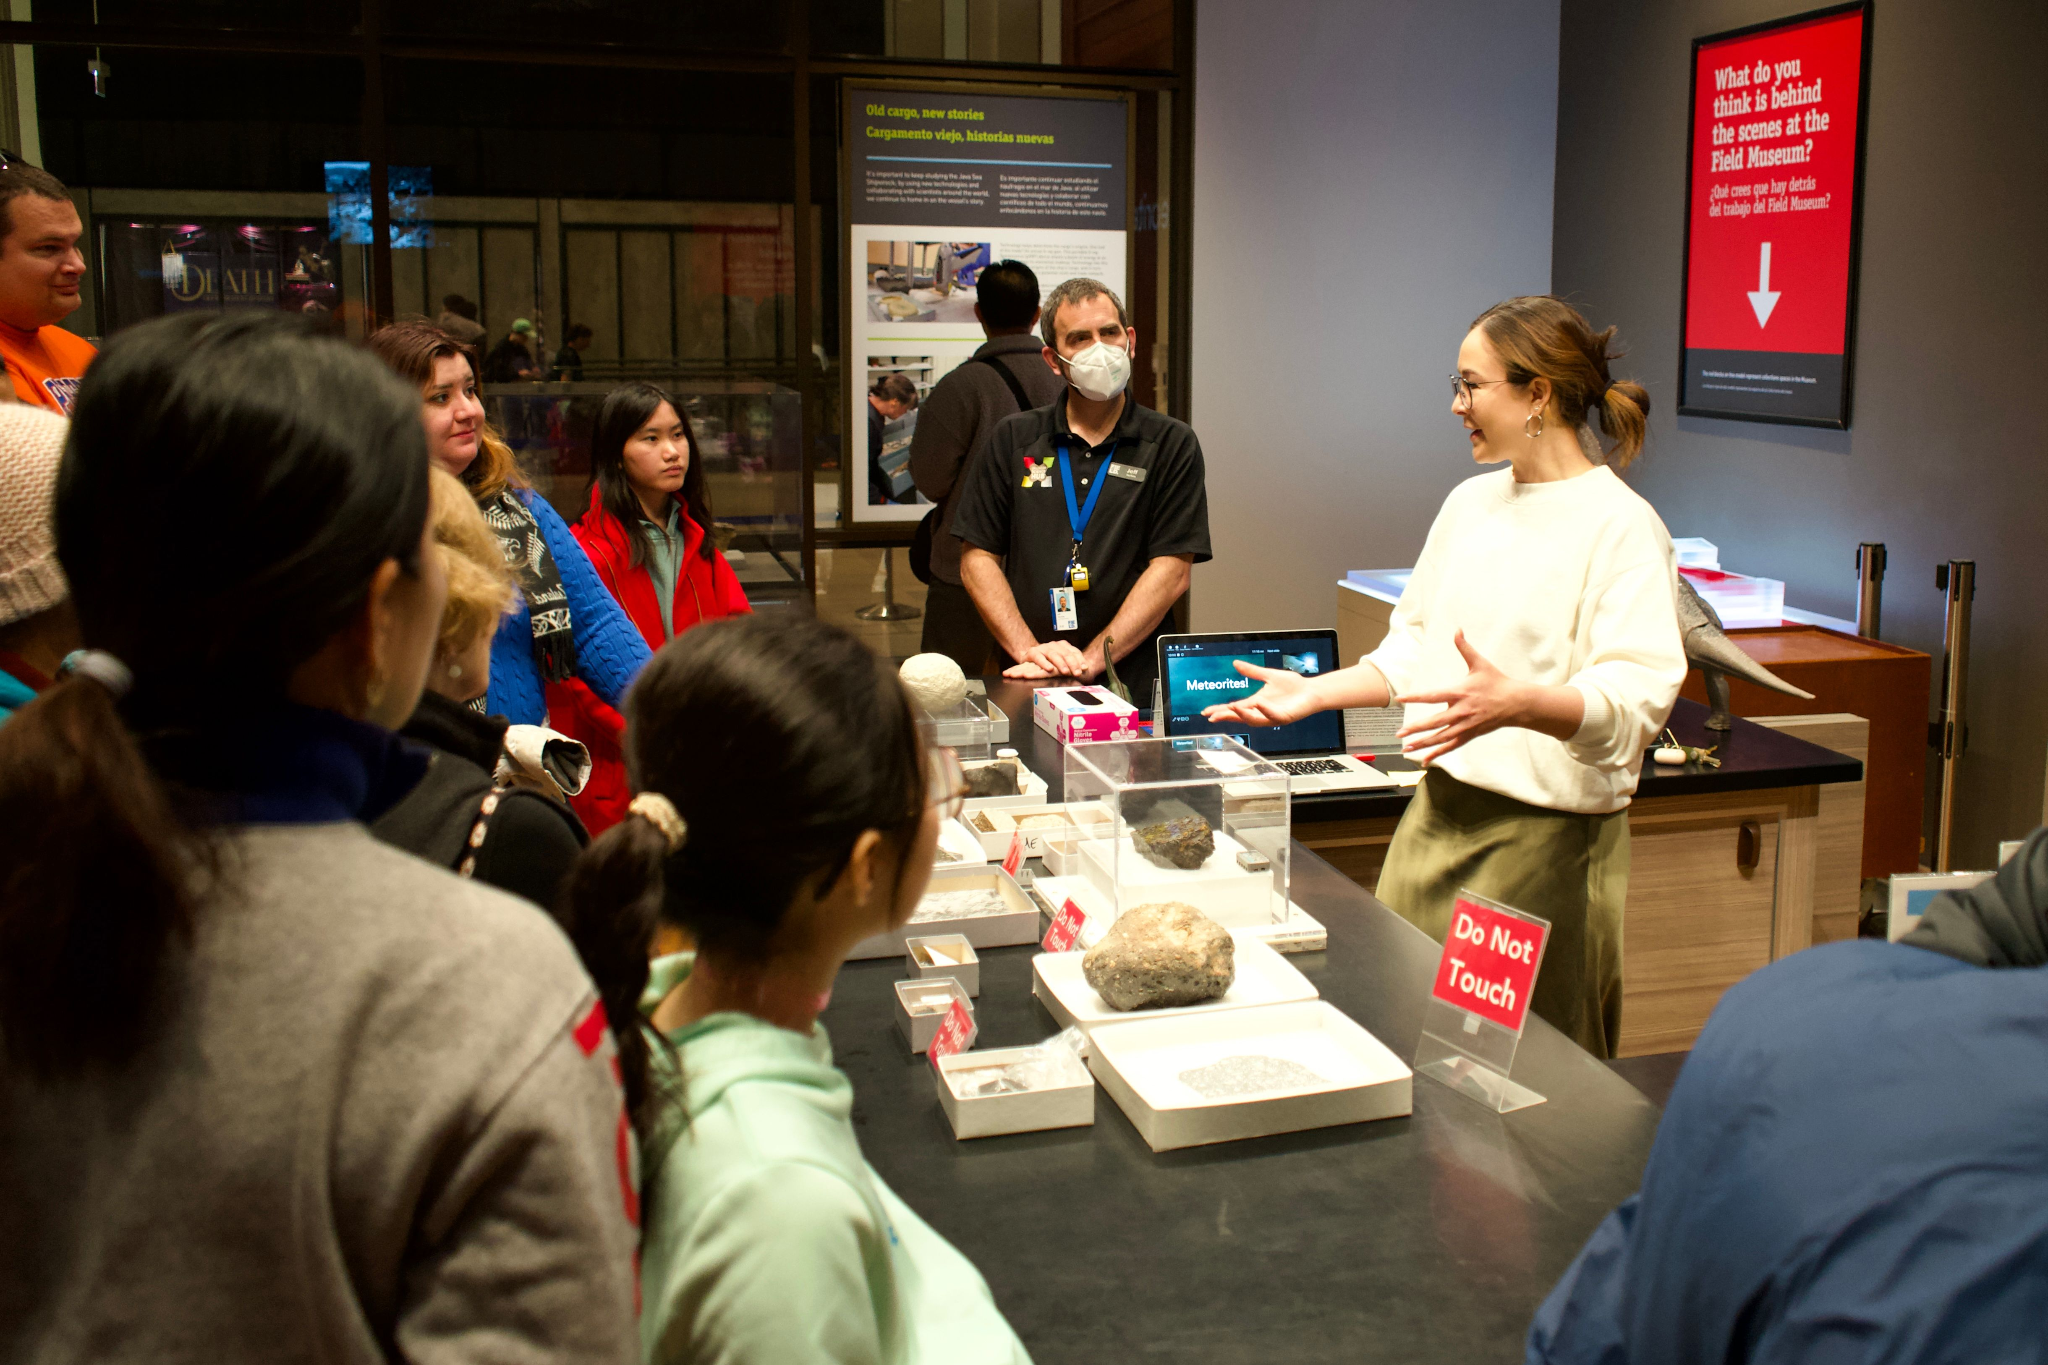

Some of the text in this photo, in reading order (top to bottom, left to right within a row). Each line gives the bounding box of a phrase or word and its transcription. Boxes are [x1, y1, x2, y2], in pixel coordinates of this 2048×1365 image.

[1715, 58, 1801, 91] What do you
[866, 104, 985, 120] Old cargo, new stories
[1714, 77, 1822, 118] think is behind
[866, 126, 1054, 144] Cargamento viejo, historias nuevas
[1712, 108, 1829, 146] the scenes at the
[1711, 138, 1813, 173] Field Museum?
[1710, 175, 1816, 202] ¿Qué crees que hay detrás
[1709, 192, 1831, 219] del trabajo del Field Museum?
[1186, 677, 1249, 691] Meteorites!
[1058, 907, 1080, 938] Do Not
[1455, 913, 1534, 965] Do Not
[1449, 957, 1516, 1012] Touch
[944, 1010, 965, 1049] Do Not
